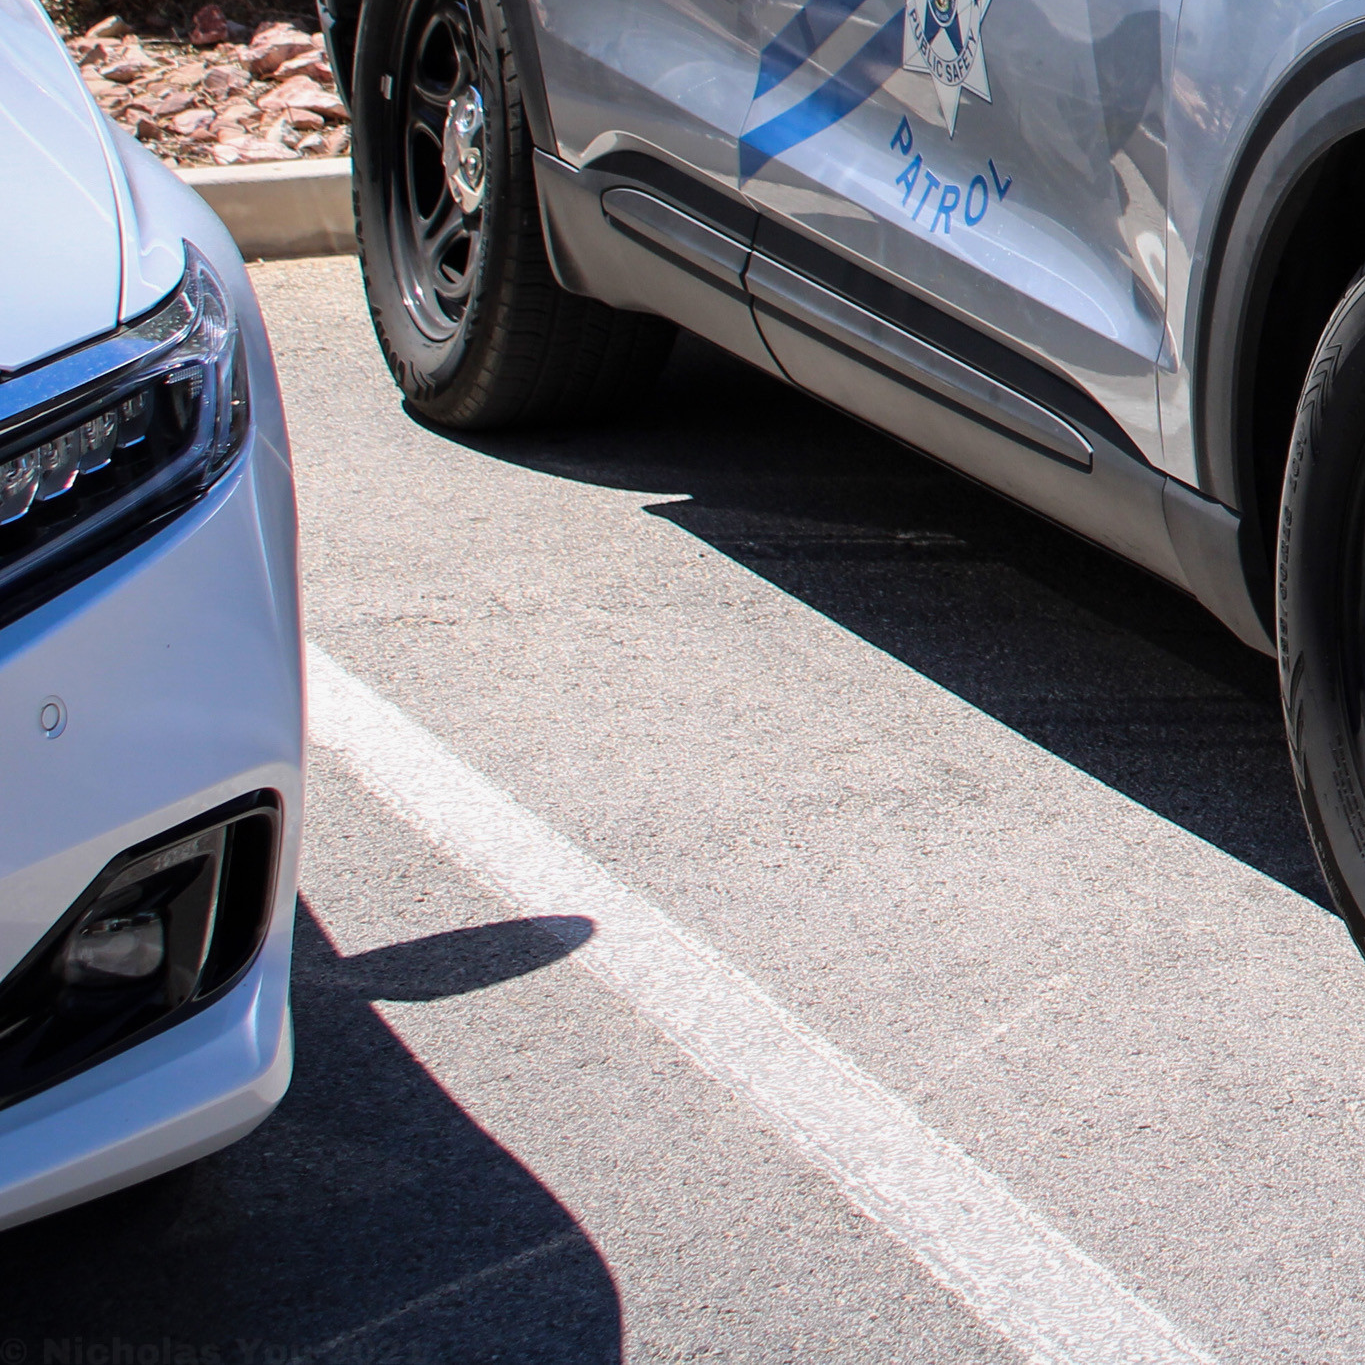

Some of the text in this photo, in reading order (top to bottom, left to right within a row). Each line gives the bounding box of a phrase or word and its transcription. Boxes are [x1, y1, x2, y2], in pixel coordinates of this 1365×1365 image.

[908, 6, 978, 83] PUBLIC SAFETY
[889, 115, 1013, 234] PATROL
